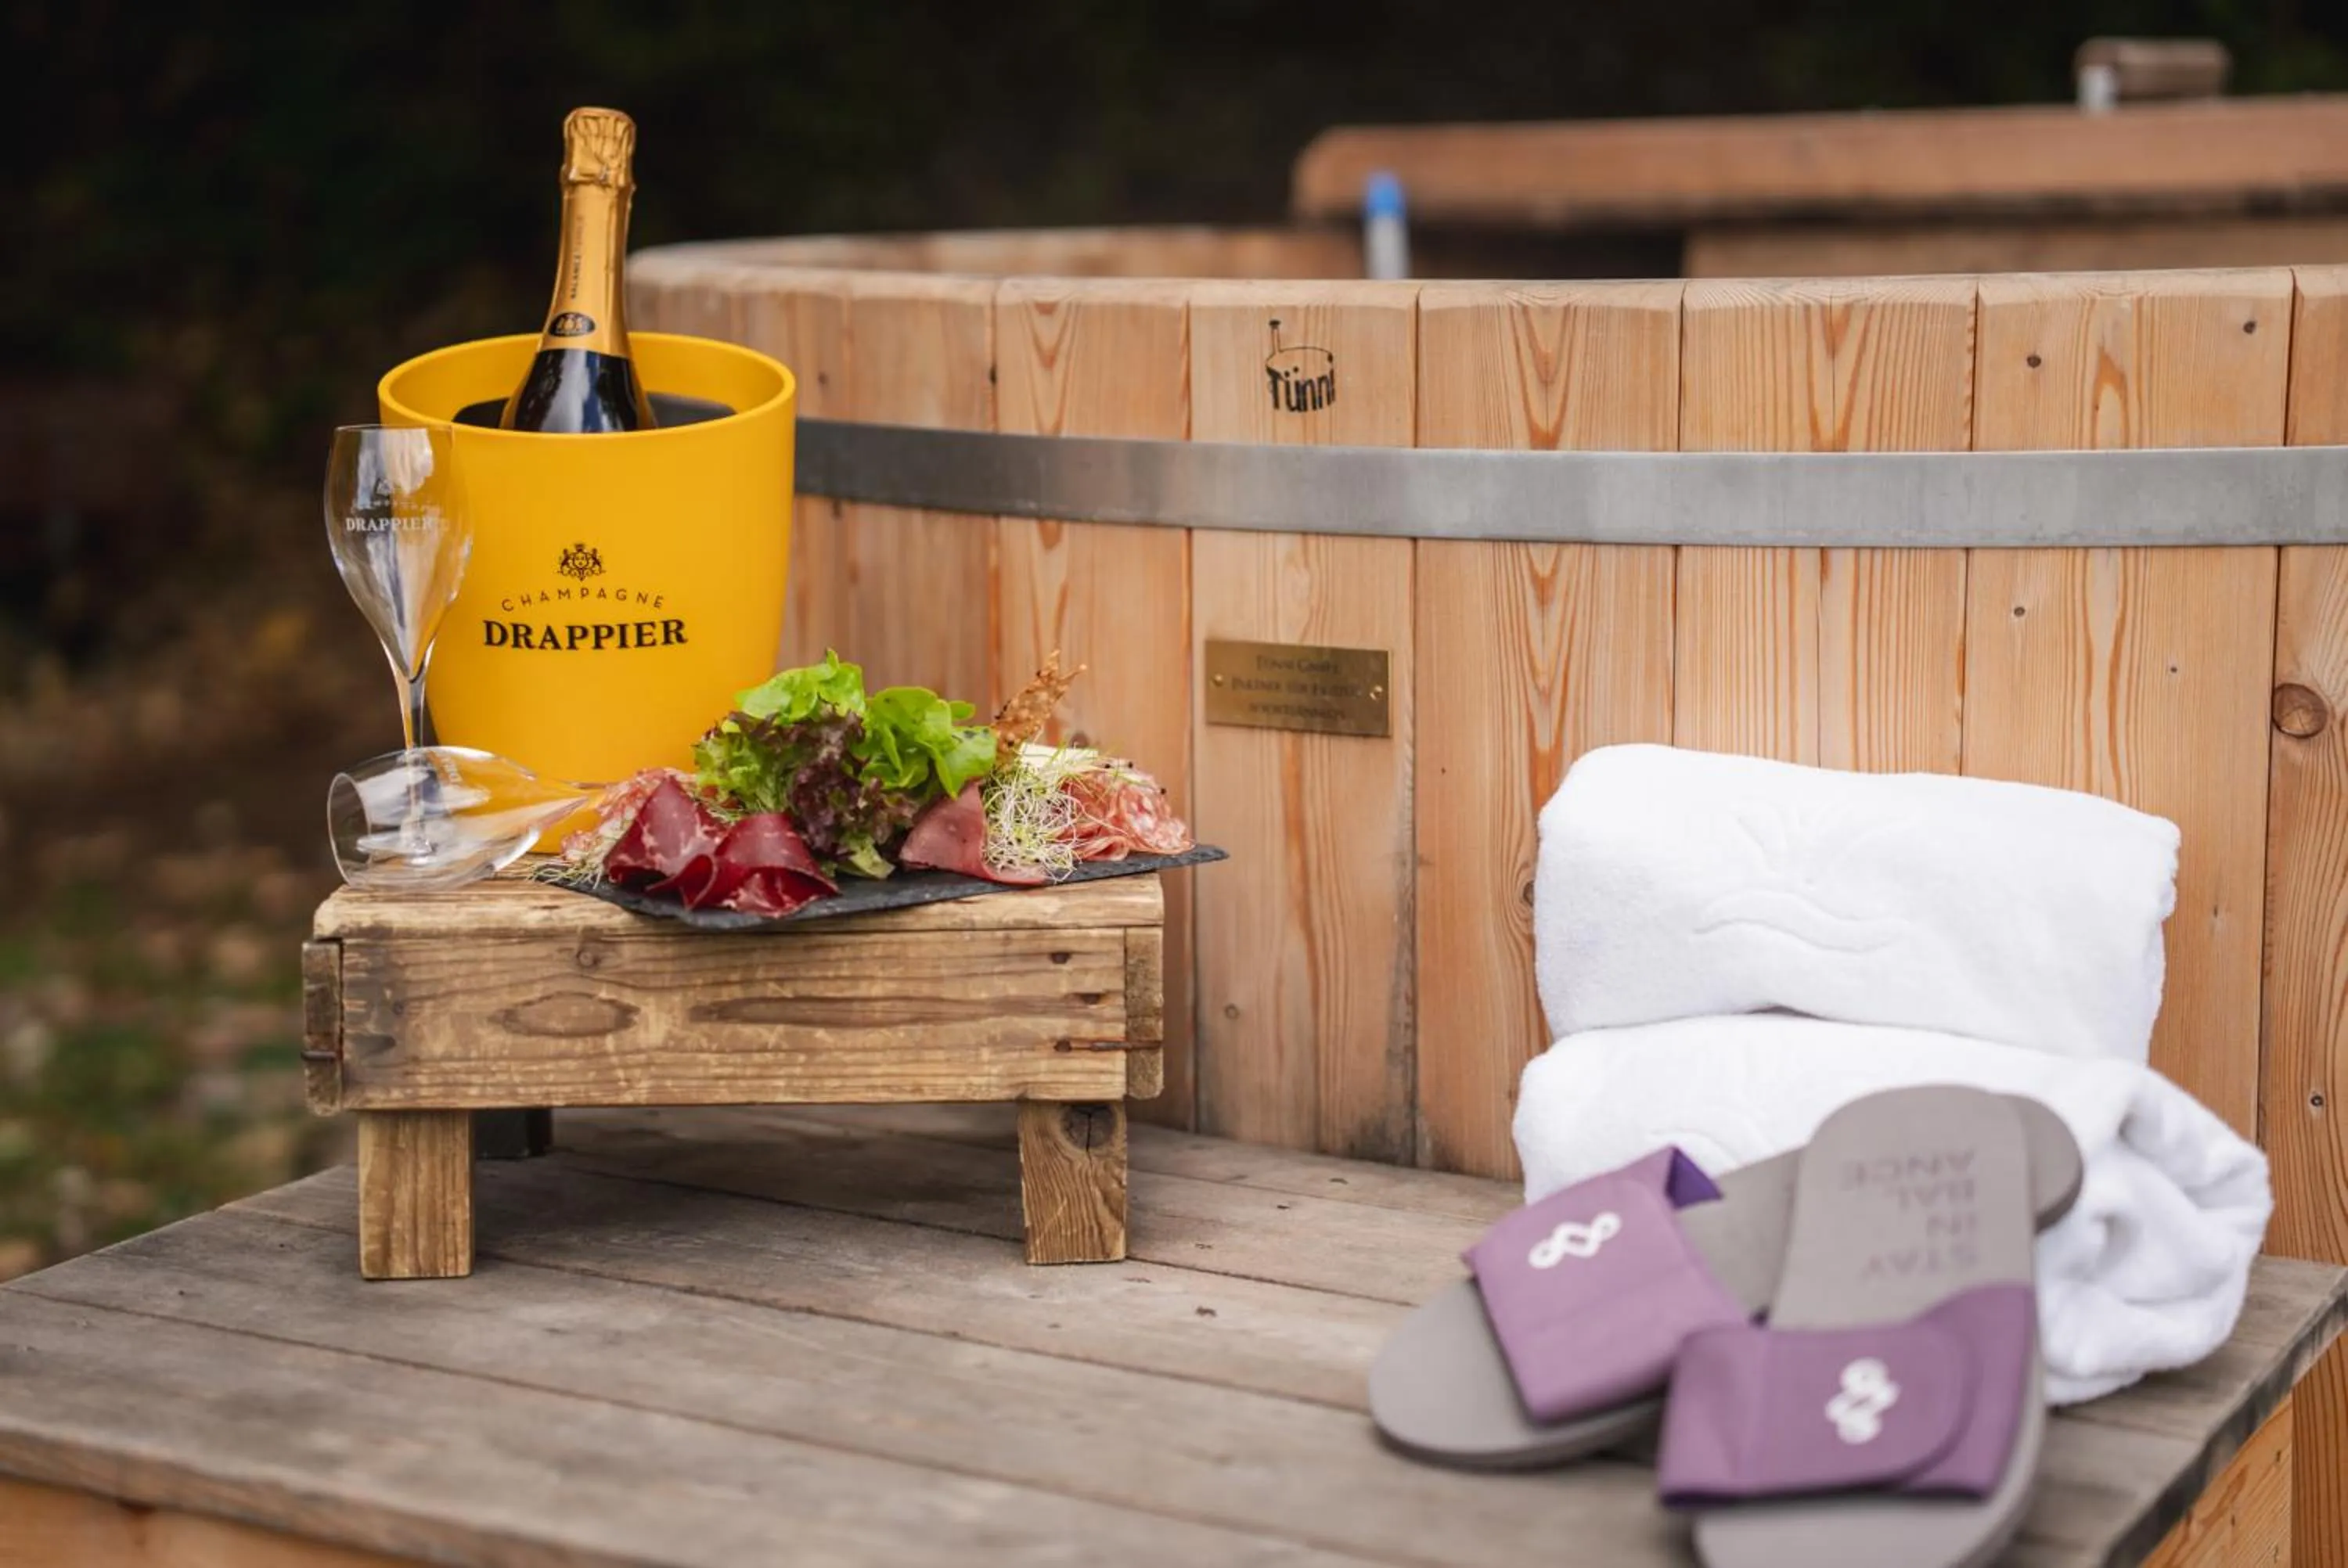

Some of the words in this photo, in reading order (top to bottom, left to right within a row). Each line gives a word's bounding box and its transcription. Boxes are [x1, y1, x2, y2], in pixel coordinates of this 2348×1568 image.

[501, 588, 664, 613] CHAMPAGNE
[482, 618, 688, 651] DRAPPIER
[1926, 1212, 1978, 1238] IN
[1858, 1244, 1978, 1281] STAY
